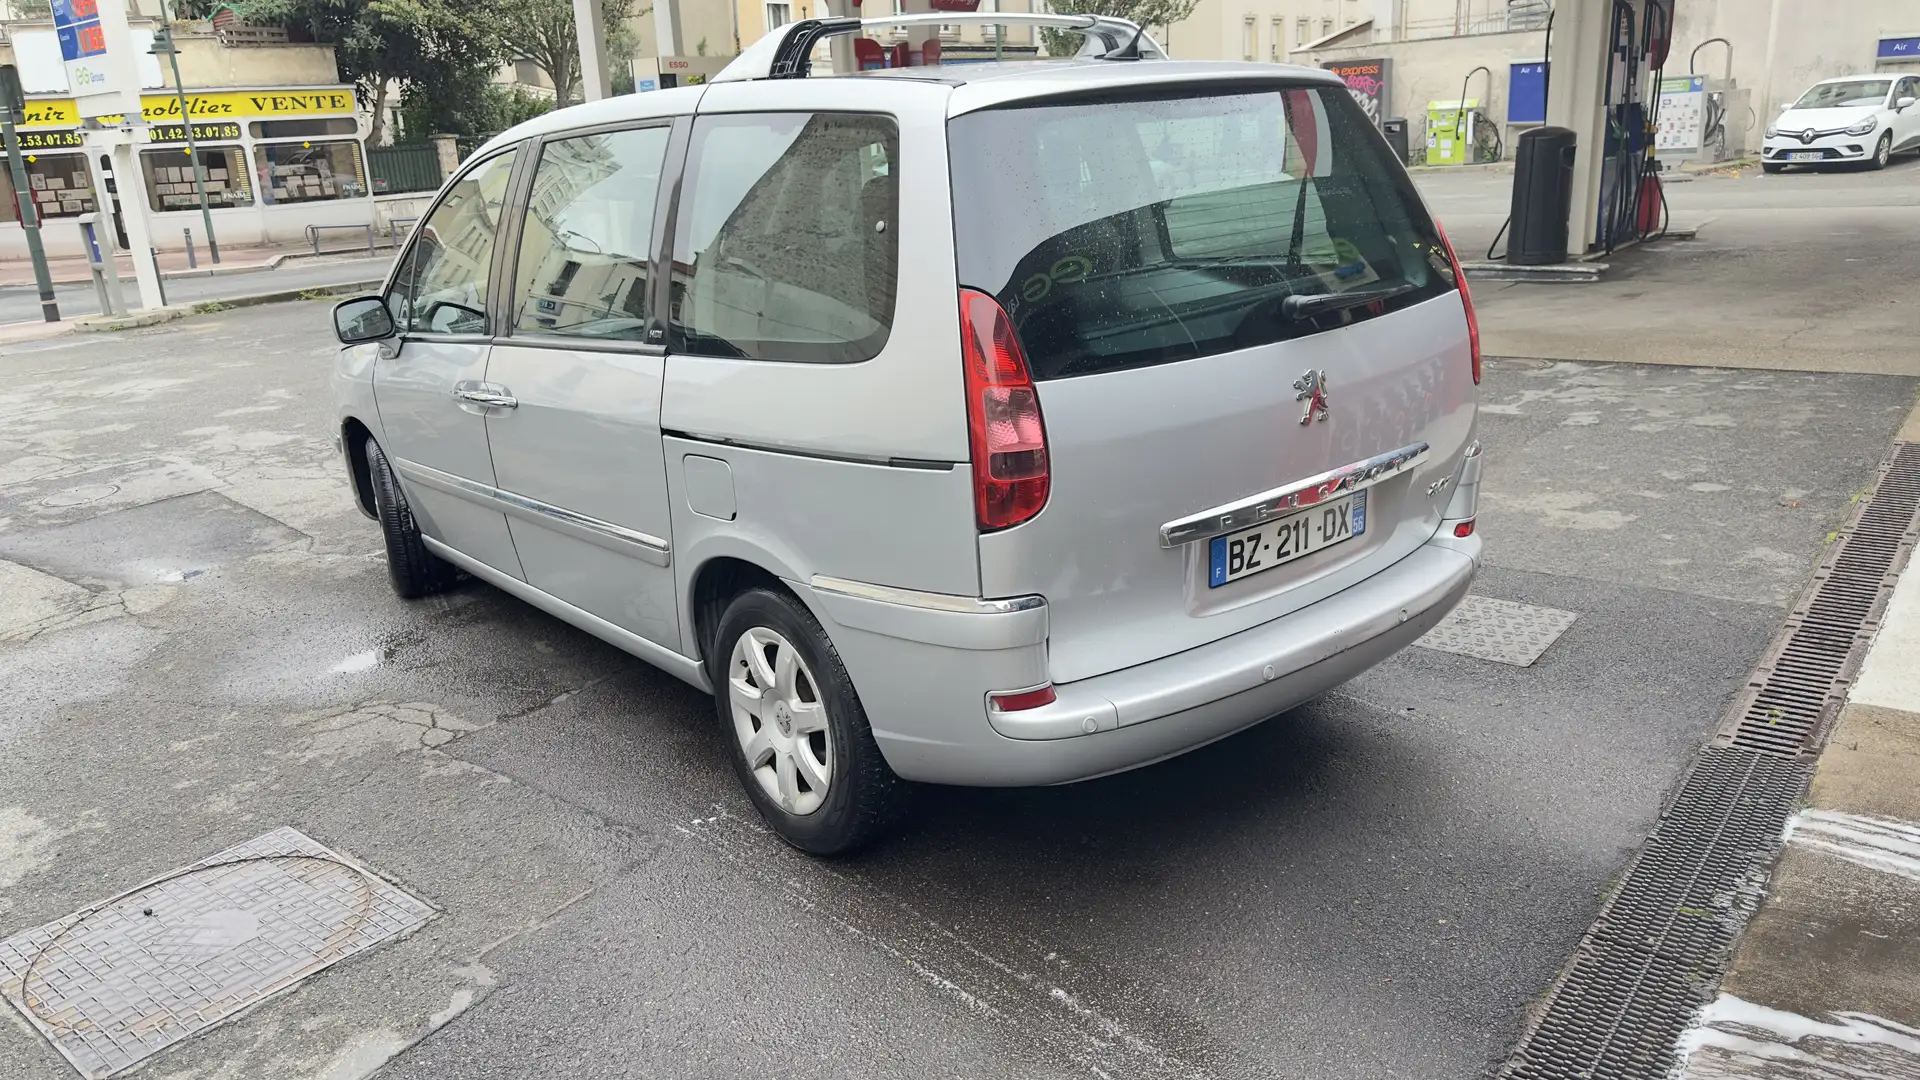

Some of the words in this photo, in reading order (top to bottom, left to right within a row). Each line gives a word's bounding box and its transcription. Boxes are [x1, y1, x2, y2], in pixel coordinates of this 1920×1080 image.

[1893, 43, 1907, 51] Air
[669, 61, 688, 69] ESSO
[1341, 64, 1379, 76] express
[90, 72, 105, 83] Group
[26, 107, 65, 122] nir
[250, 95, 346, 111] VENTE
[223, 191, 246, 200] FNAIM
[1220, 457, 1405, 531] PEUGEOT
[1352, 515, 1364, 533] 56
[1215, 567, 1222, 578] F
